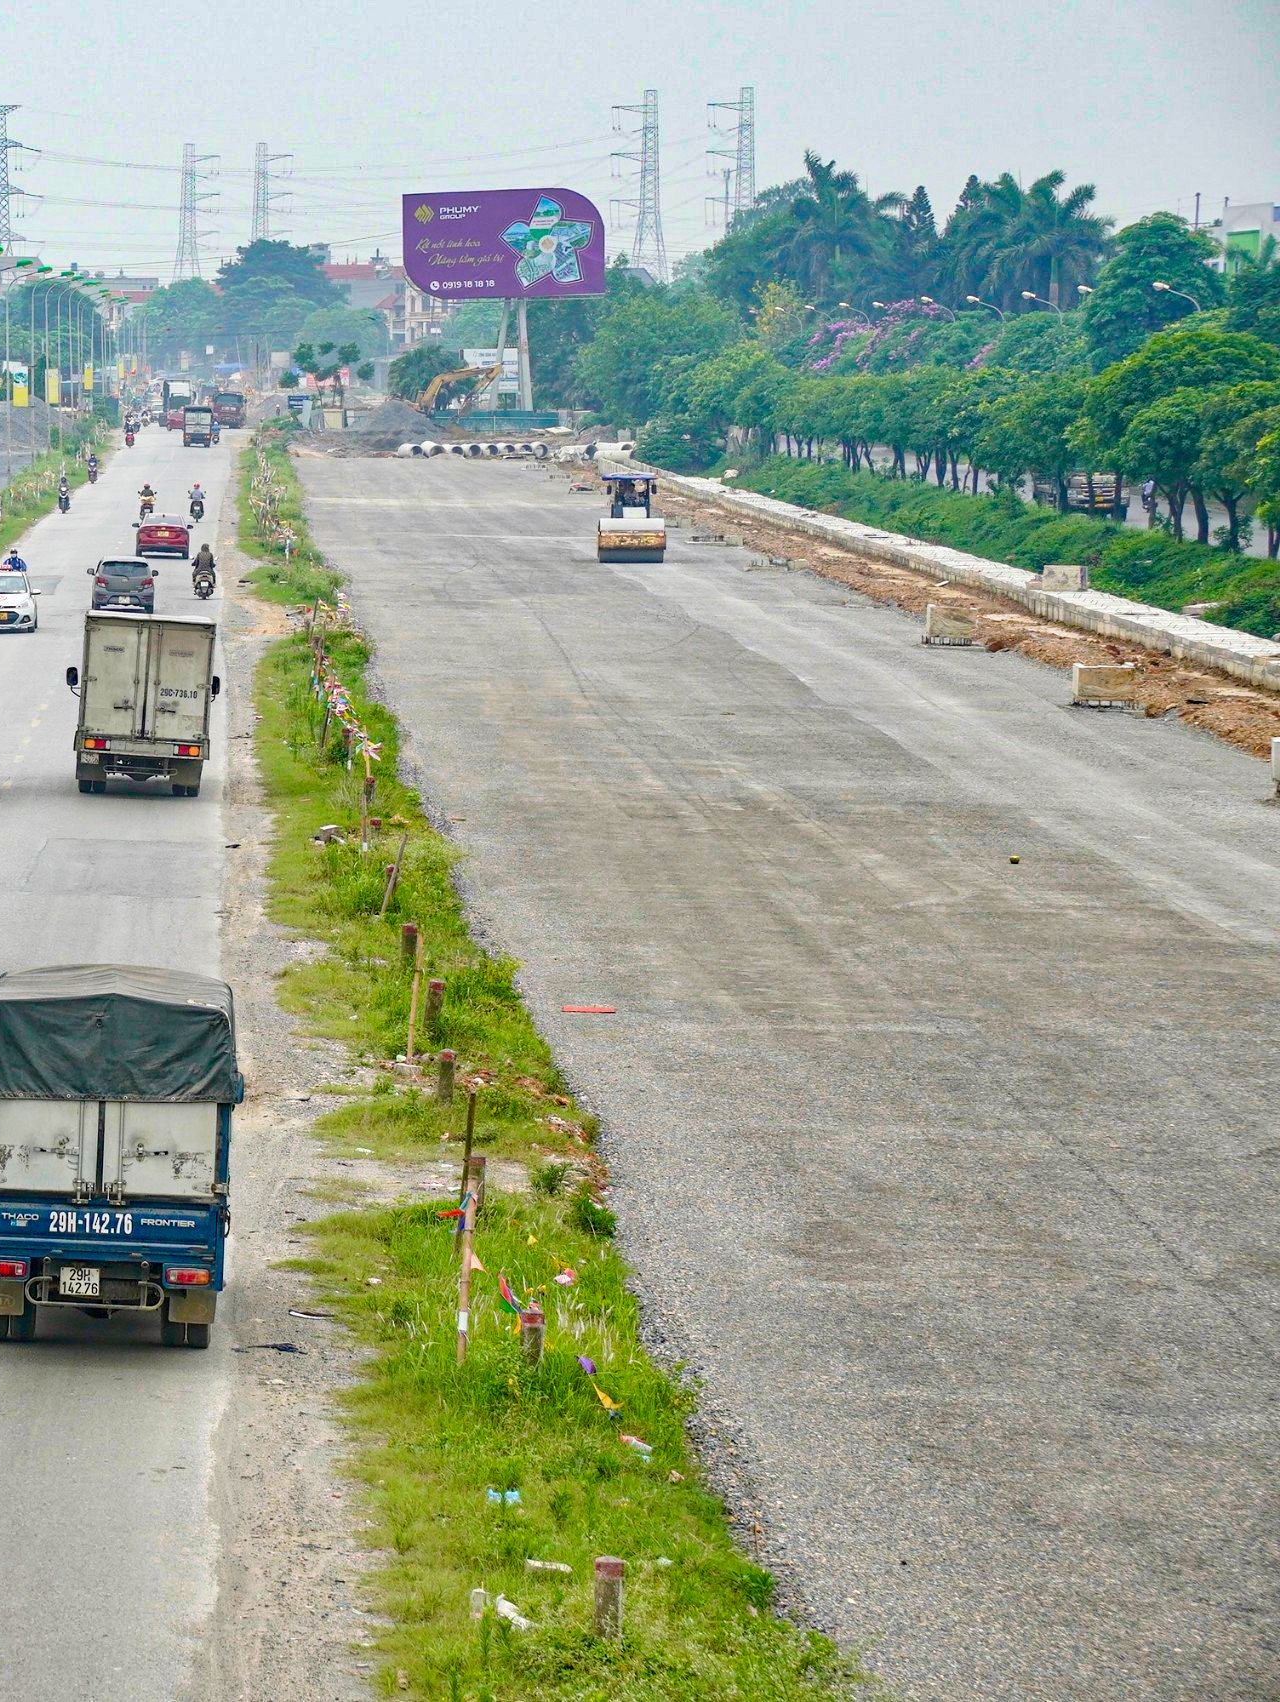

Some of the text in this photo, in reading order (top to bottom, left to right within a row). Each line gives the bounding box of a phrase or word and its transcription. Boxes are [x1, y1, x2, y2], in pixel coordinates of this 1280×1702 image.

[439, 205, 480, 214] PHUMY
[442, 279, 495, 289] 0919 18 18 18
[1, 1212, 40, 1221] THACO
[48, 1211, 133, 1235] 29H-142.76
[140, 1218, 196, 1228] FRONTIER
[69, 1268, 91, 1282] 29H
[62, 1281, 98, 1295] 142.76
